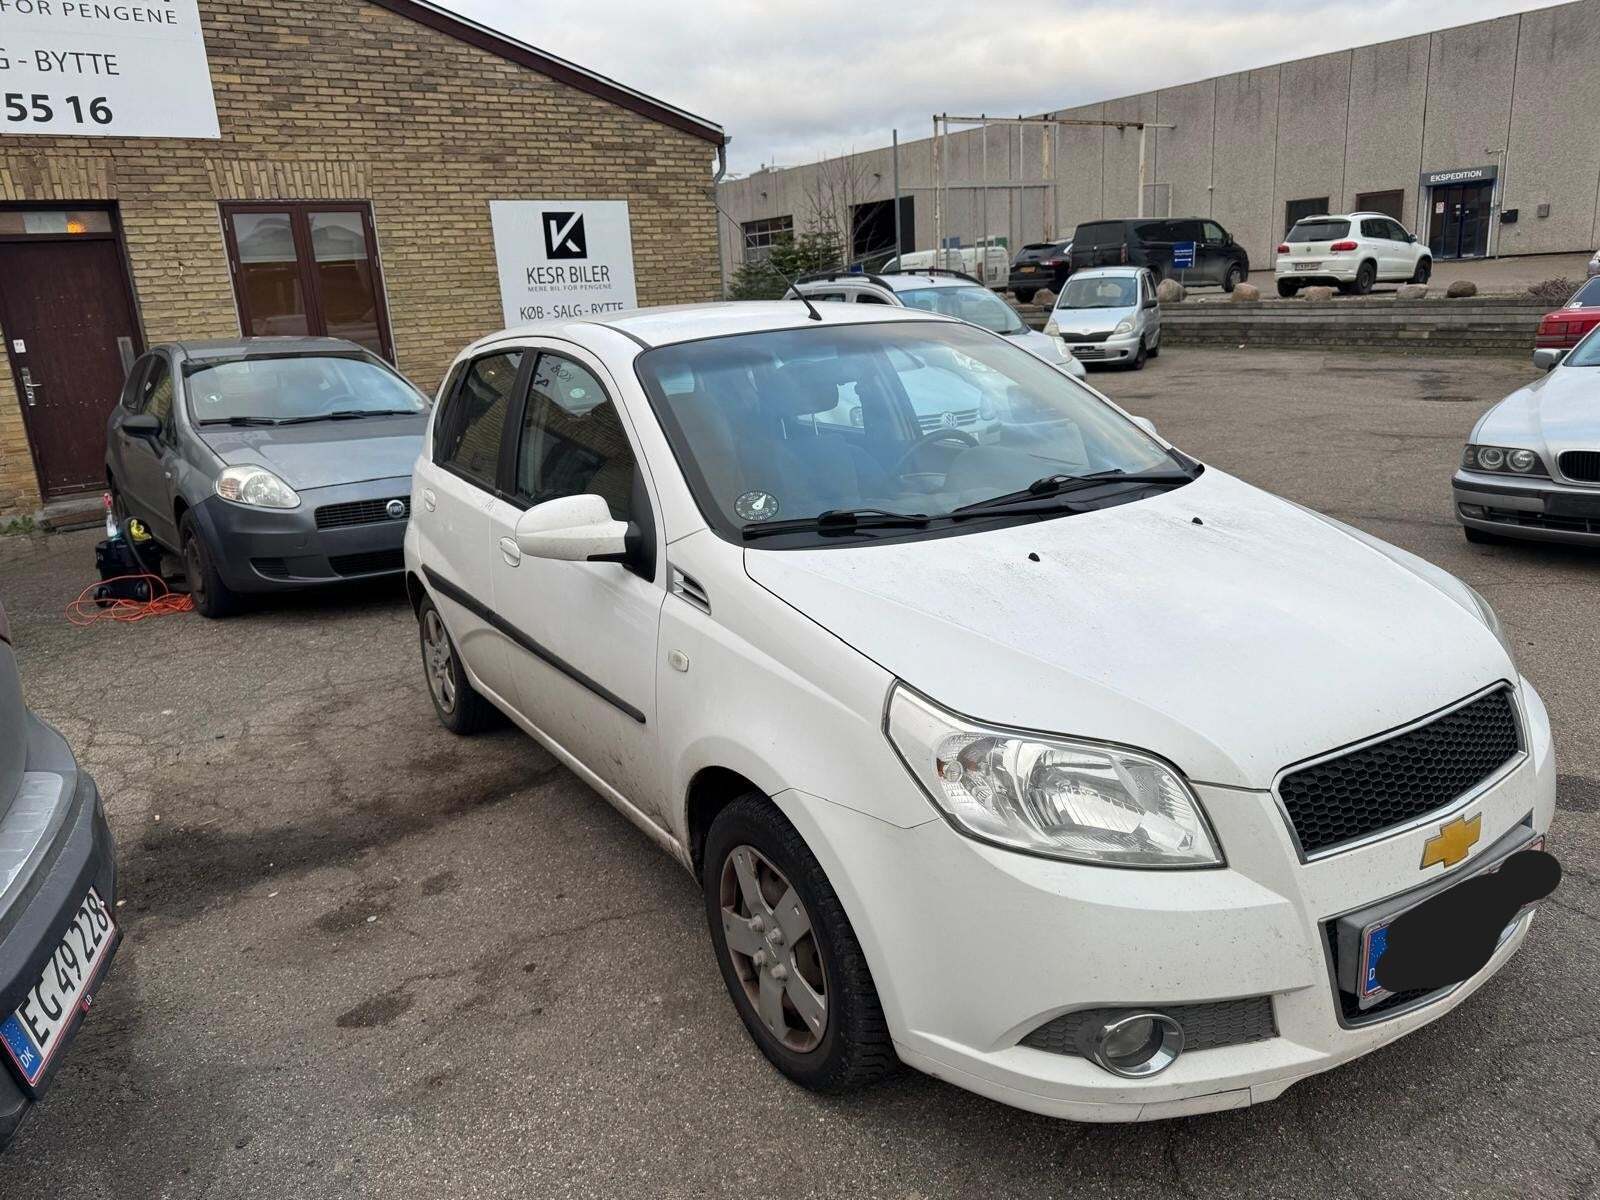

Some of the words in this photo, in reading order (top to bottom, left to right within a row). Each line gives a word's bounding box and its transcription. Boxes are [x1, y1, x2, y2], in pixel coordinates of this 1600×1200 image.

[0, 0, 51, 15] FOR
[62, 1, 178, 25] PENGENE
[34, 50, 120, 76] BYTTE
[4, 93, 54, 122] 55
[65, 95, 113, 125] 16
[1430, 170, 1482, 182] EKSPEDITION
[526, 266, 566, 285] KESR
[569, 265, 611, 284] BILER
[563, 284, 578, 292] FOR
[580, 283, 613, 291] PENGENE
[519, 305, 544, 320] KØB
[553, 304, 583, 319] SALG
[18, 982, 64, 1049] EG
[51, 939, 82, 997] 49
[70, 893, 109, 964] 228
[20, 1046, 35, 1068] DK
